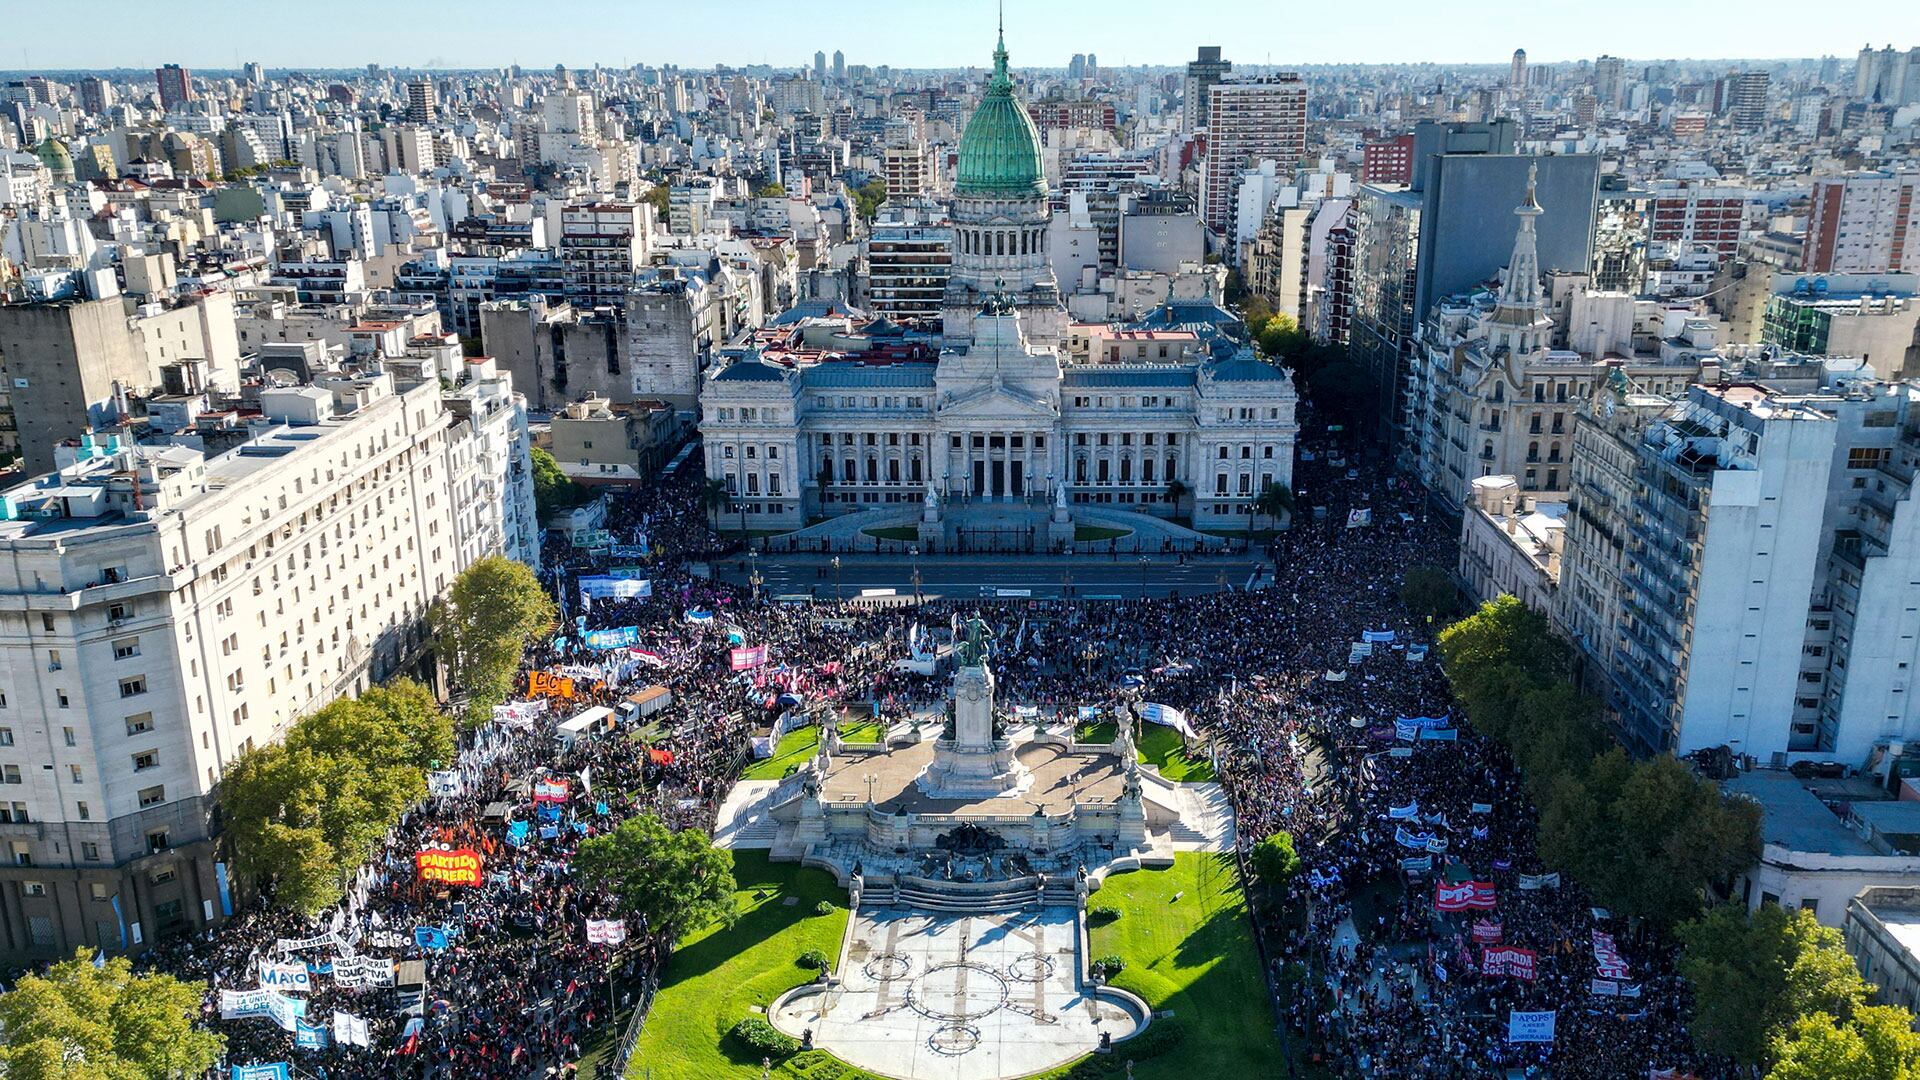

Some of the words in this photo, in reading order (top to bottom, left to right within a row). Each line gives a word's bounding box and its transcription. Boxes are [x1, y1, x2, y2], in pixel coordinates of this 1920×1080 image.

[420, 854, 477, 870] PARTIDO
[422, 868, 476, 882] OBRERO
[1439, 884, 1474, 902] PTS
[1485, 950, 1532, 967] IZQUIERDA
[261, 968, 308, 985] MAYO
[1482, 962, 1532, 980] SOCILISTA
[1519, 1014, 1550, 1022] APOPS
